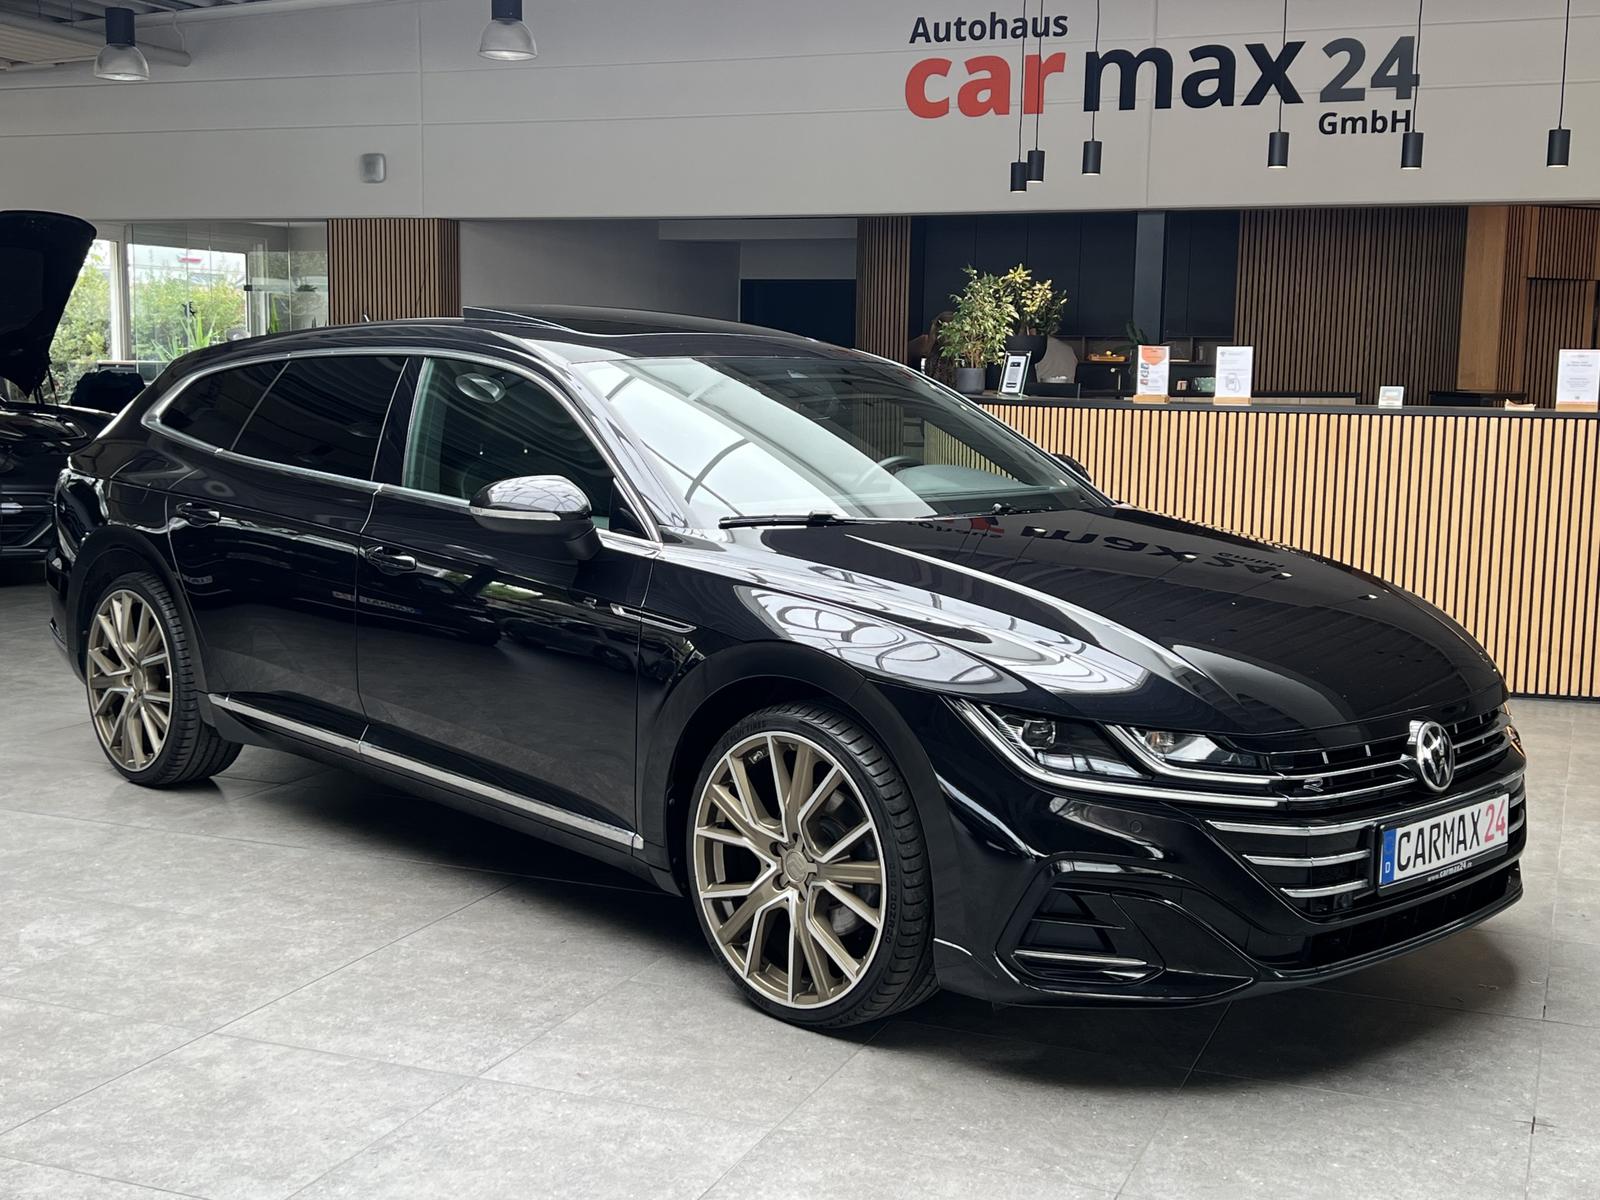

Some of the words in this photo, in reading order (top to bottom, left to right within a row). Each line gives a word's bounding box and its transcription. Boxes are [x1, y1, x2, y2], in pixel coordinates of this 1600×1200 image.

[909, 12, 1069, 44] Autohaus
[1319, 36, 1420, 102] 24
[1318, 109, 1412, 135] GmbH
[1385, 861, 1391, 874] D
